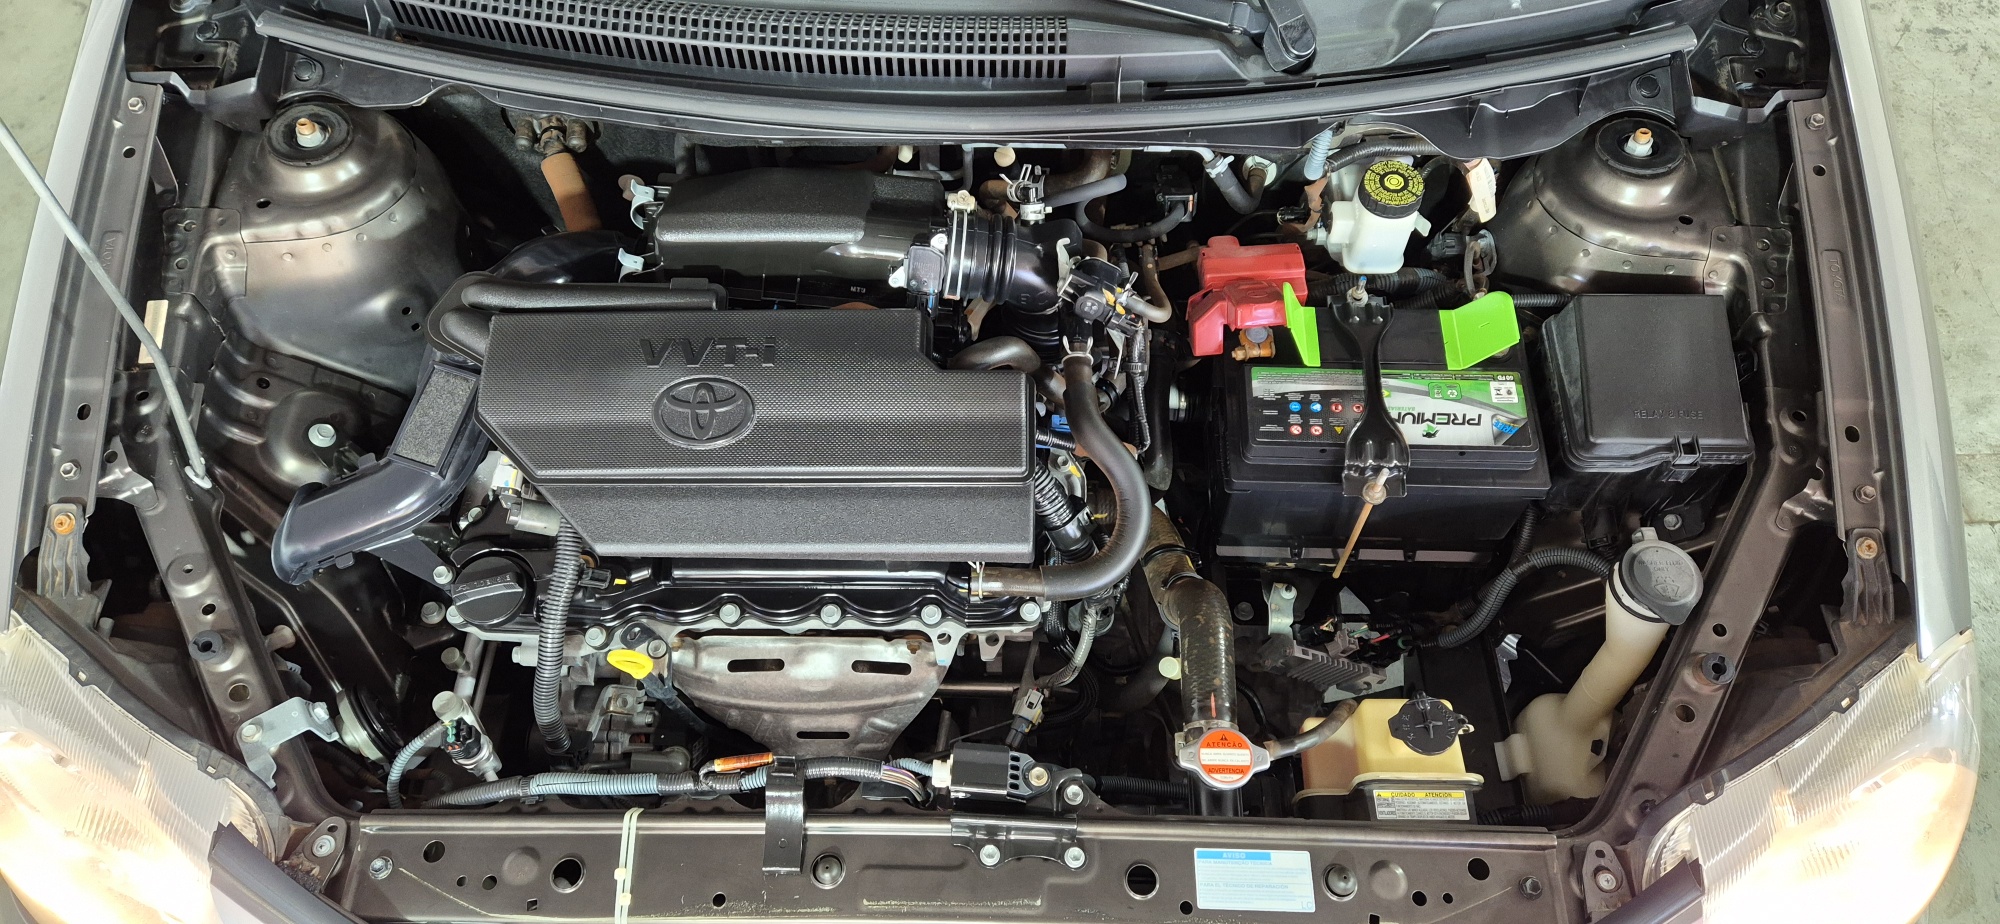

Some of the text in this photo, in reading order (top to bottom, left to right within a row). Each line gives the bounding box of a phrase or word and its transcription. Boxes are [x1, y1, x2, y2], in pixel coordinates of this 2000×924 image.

[1829, 256, 1846, 300] TOYOTA
[639, 337, 776, 368] VVT-i
[1633, 409, 1665, 419] RELAY
[1678, 410, 1704, 420] FUSE
